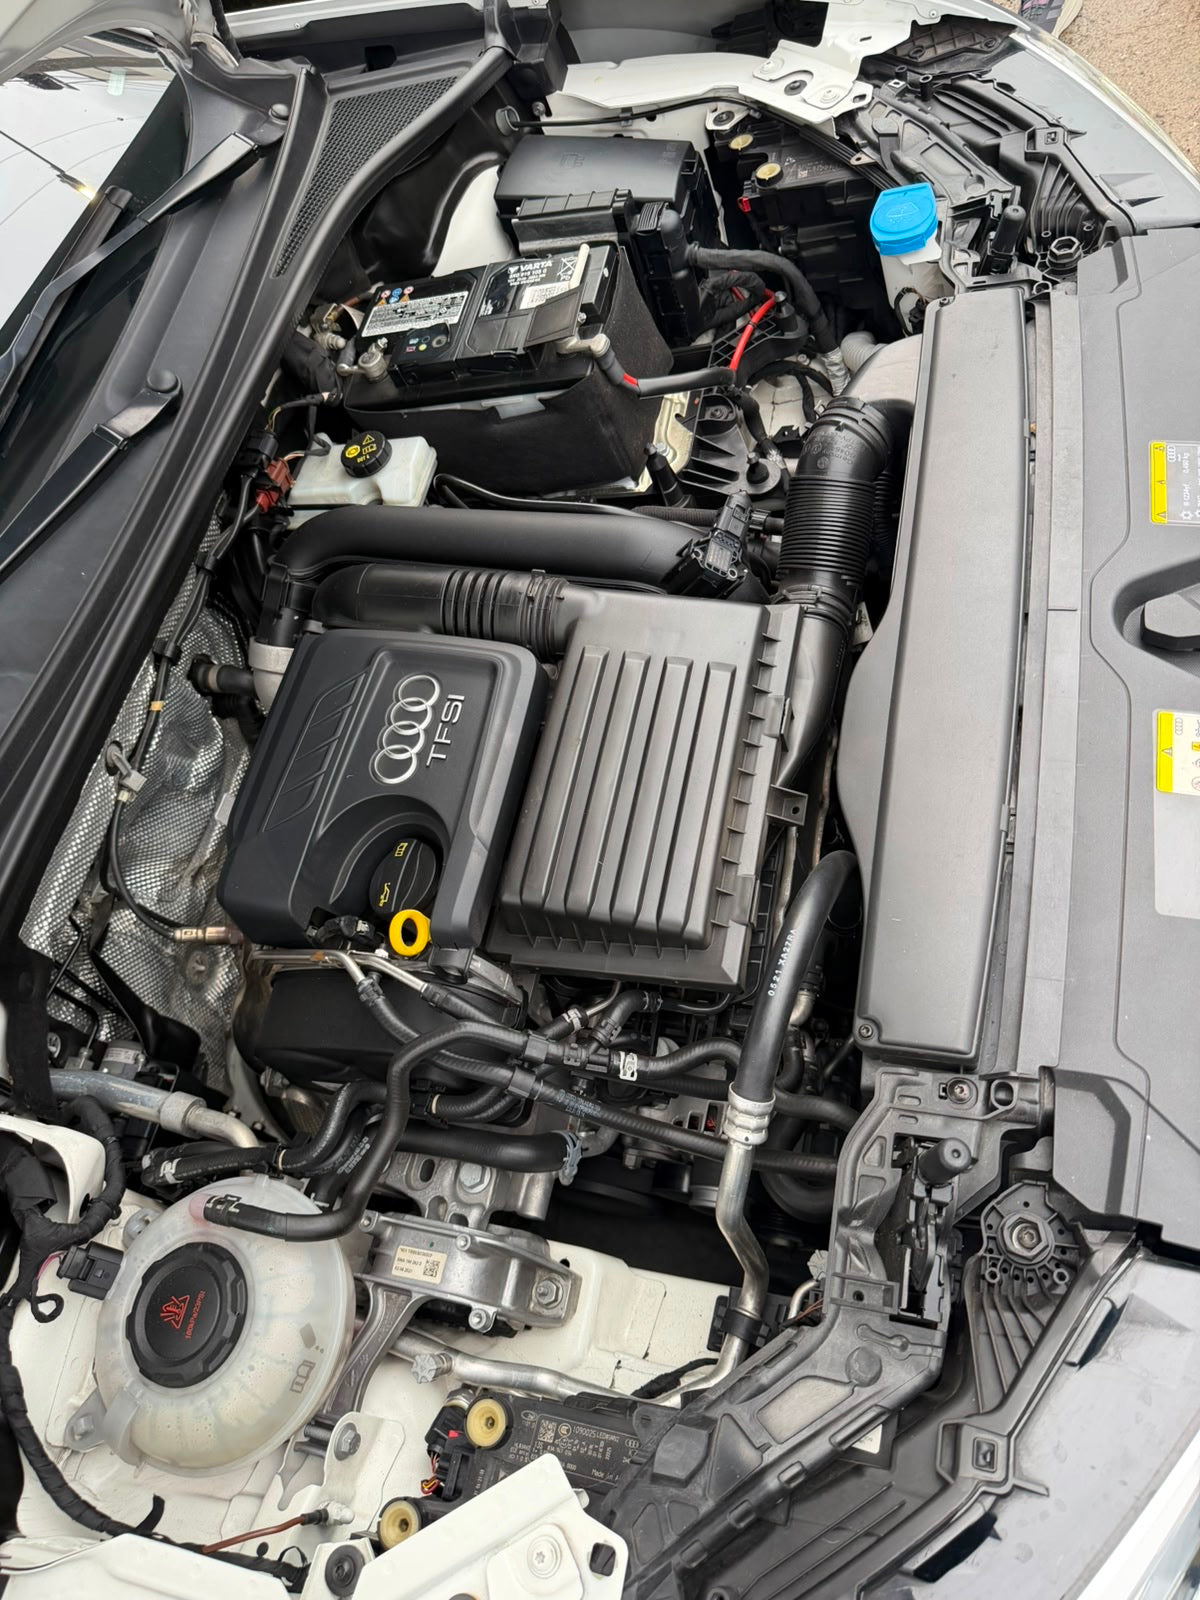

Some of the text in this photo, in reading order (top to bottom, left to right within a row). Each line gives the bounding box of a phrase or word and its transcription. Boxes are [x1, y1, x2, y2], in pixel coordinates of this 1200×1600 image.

[520, 260, 552, 271] VARTA
[426, 694, 465, 767] TFSI
[767, 969, 782, 997] 0521
